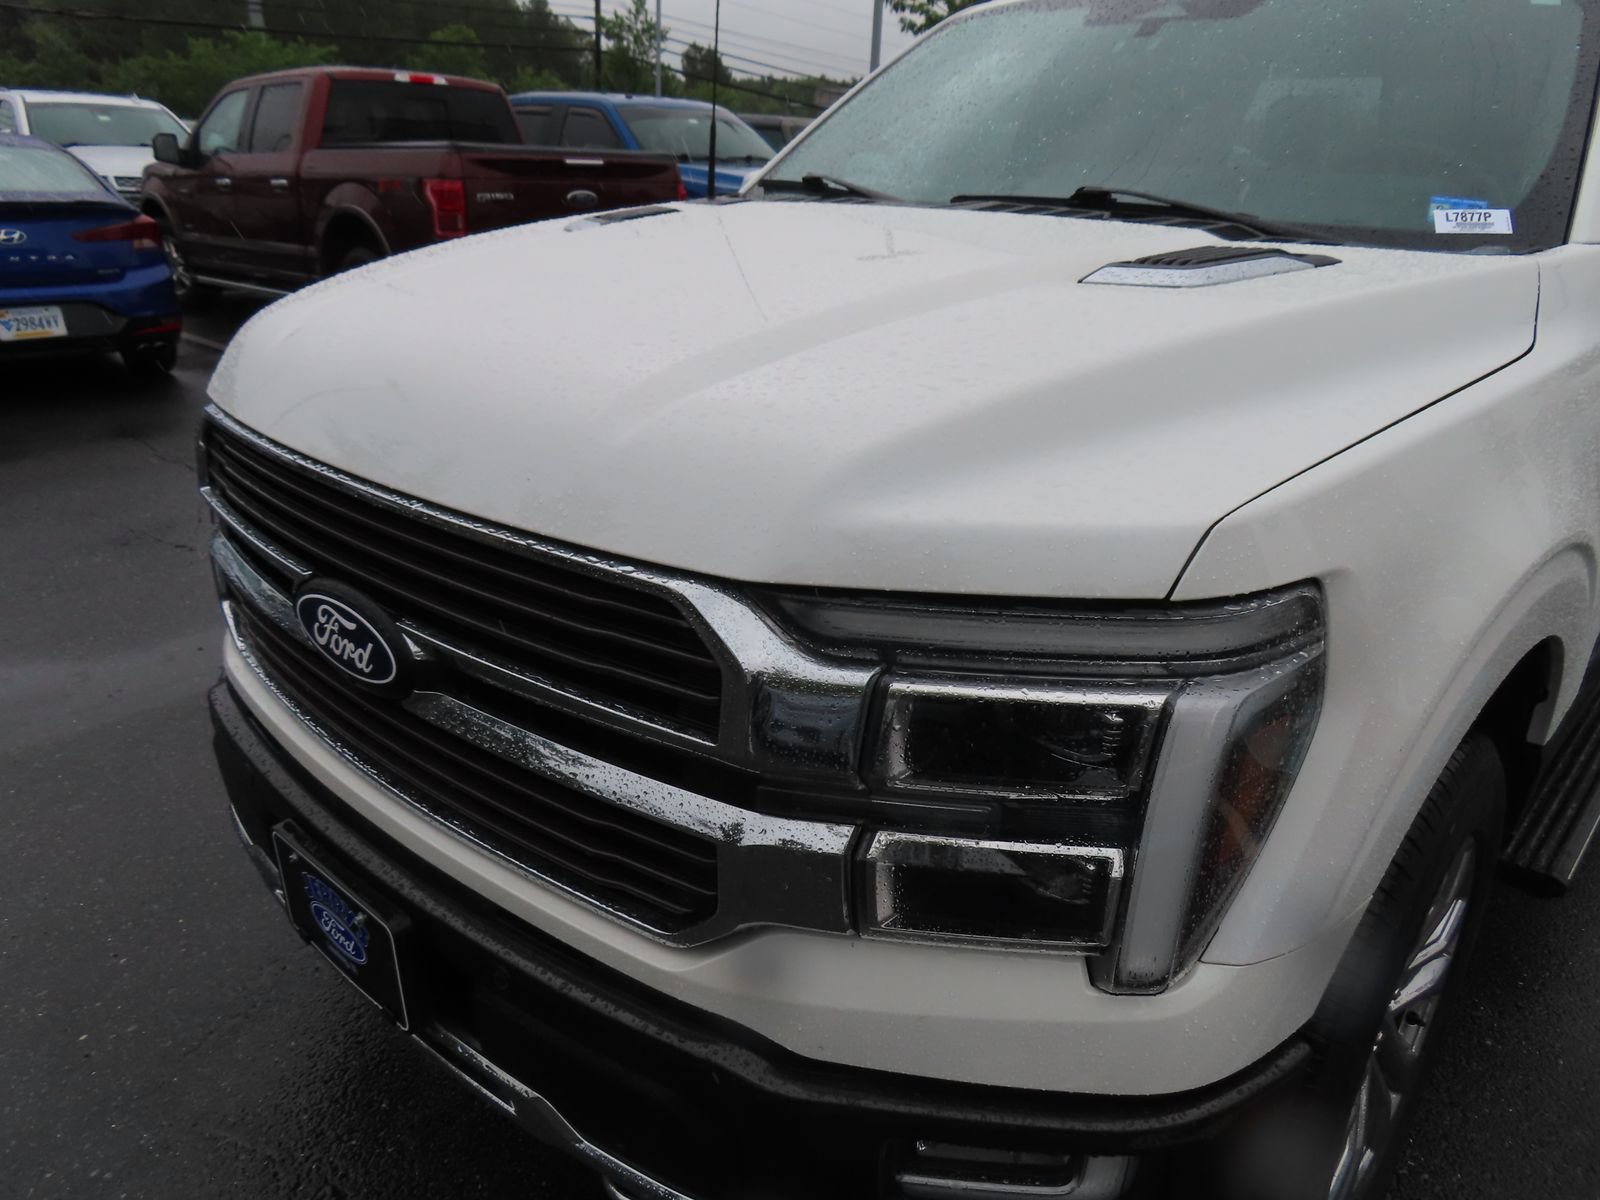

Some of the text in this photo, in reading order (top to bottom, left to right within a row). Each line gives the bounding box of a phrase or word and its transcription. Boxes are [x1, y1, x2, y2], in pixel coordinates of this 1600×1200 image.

[1445, 212, 1492, 222] L7877P
[314, 604, 374, 673] Ford
[321, 910, 356, 955] Ford
